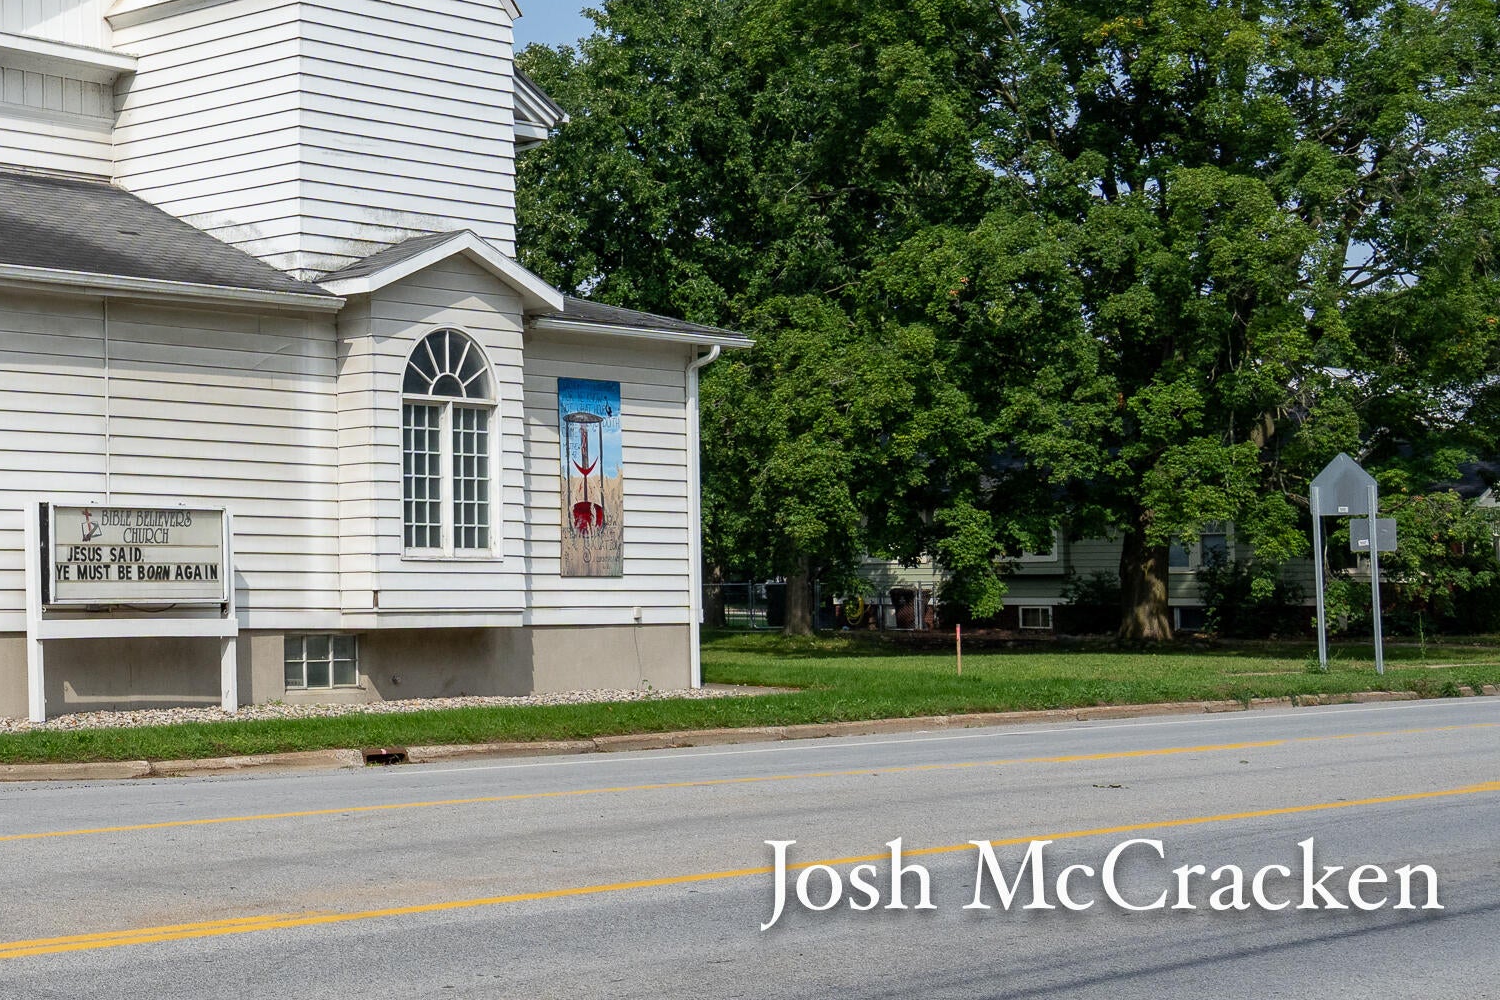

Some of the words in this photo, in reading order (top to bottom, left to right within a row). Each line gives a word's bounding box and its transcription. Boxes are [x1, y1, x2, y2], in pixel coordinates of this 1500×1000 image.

[101, 510, 131, 526] BIBLE
[136, 511, 192, 528] BELIEVERS
[123, 527, 169, 544] CHURCH
[67, 546, 102, 562] JESUS
[56, 565, 70, 580] YE
[77, 564, 111, 580] MUST
[118, 565, 132, 580] BE
[138, 565, 170, 580] BORN
[175, 564, 218, 580] AGAIN
